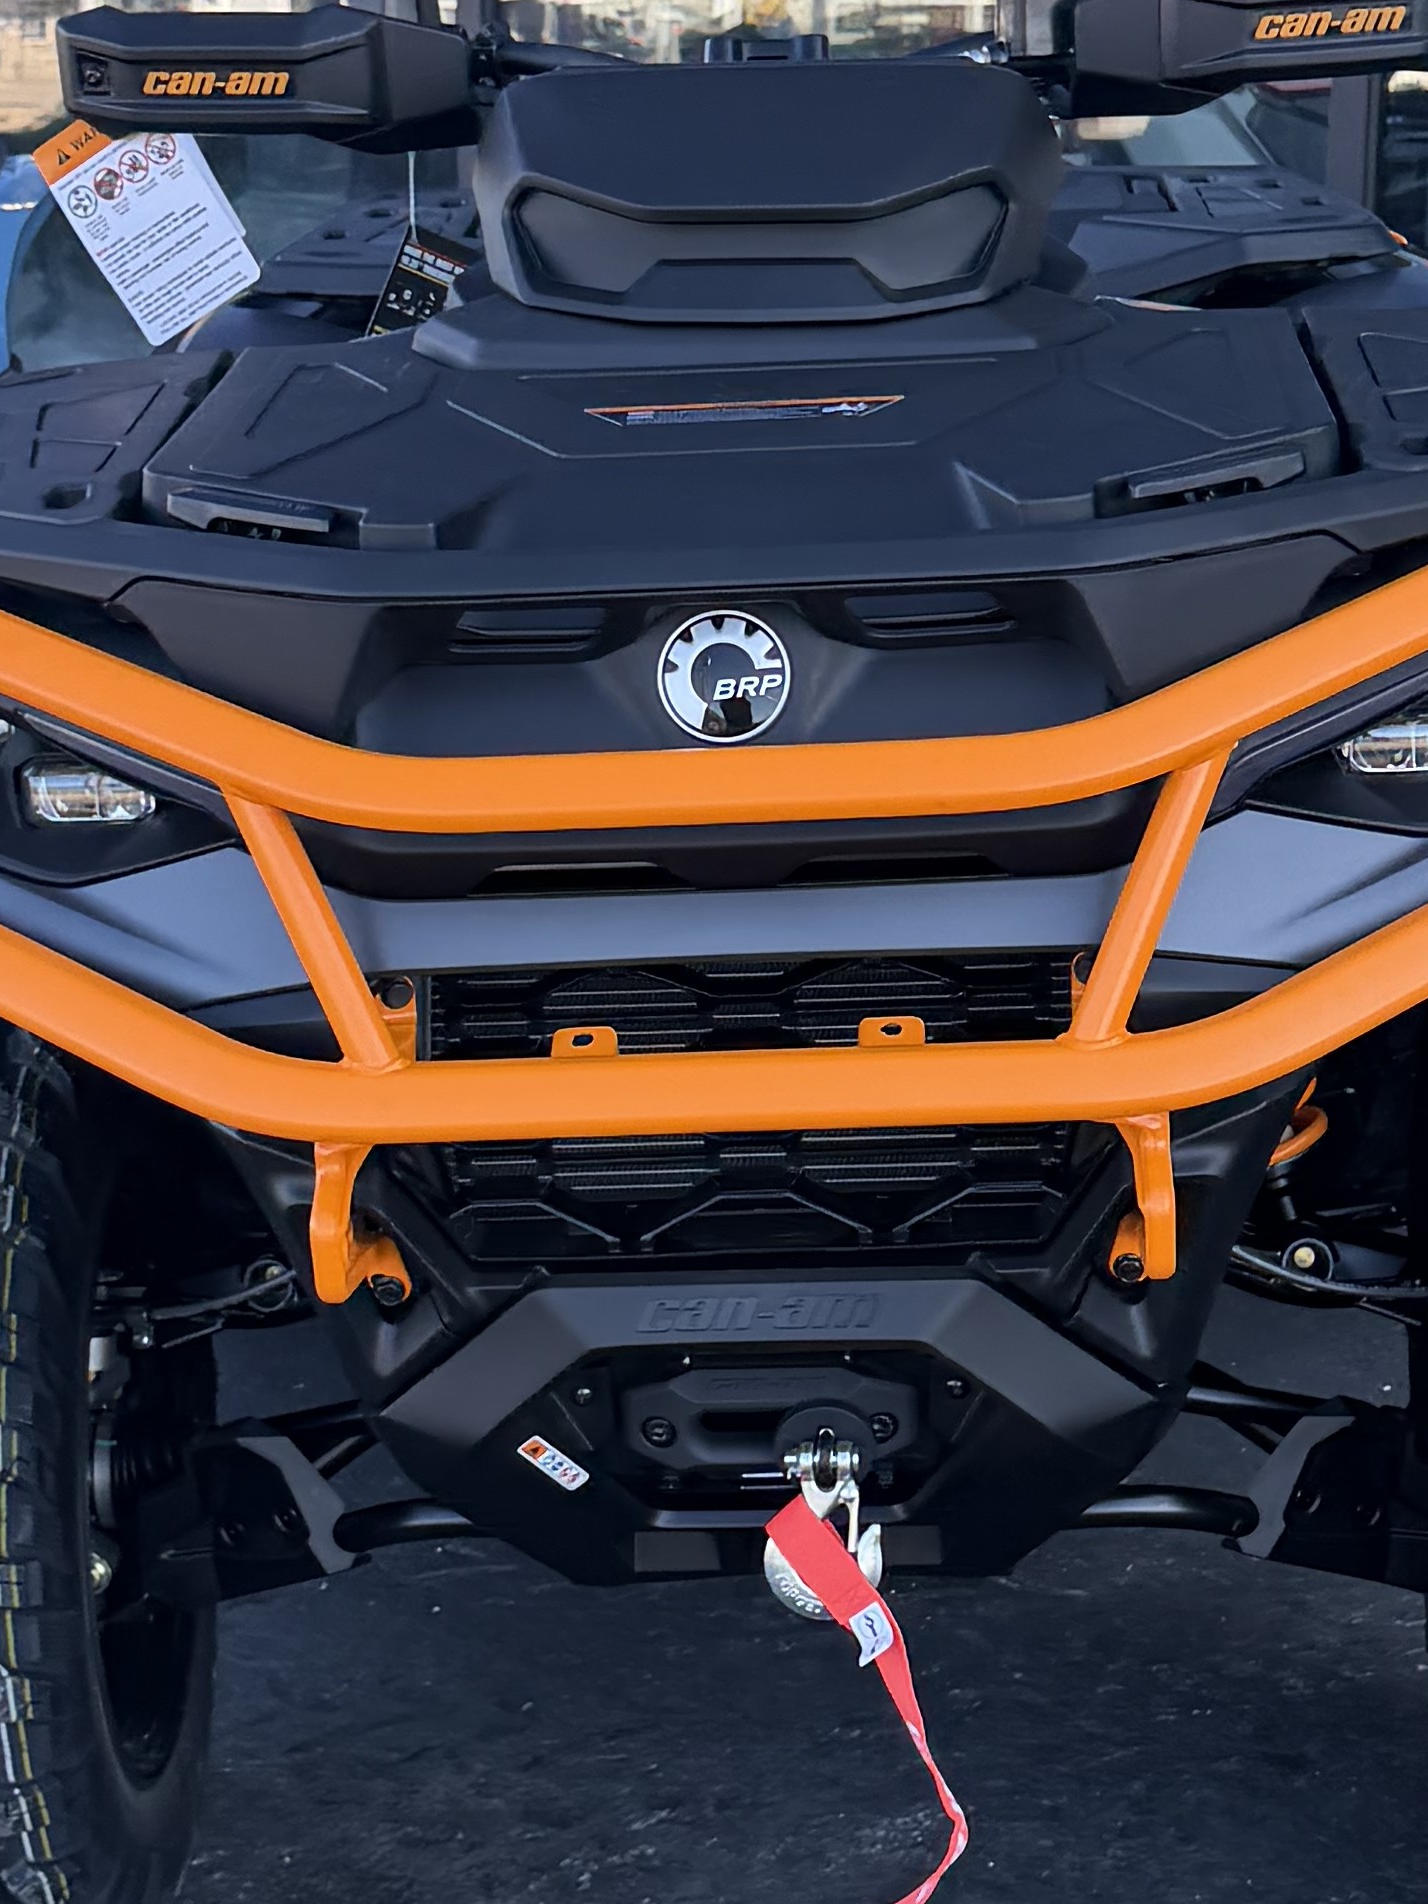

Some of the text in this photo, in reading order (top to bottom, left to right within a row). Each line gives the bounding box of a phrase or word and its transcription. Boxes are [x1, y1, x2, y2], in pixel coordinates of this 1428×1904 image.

[1253, 3, 1408, 41] can-am
[143, 69, 290, 97] can-am
[713, 672, 783, 701] BRP
[636, 1293, 881, 1333] can-am
